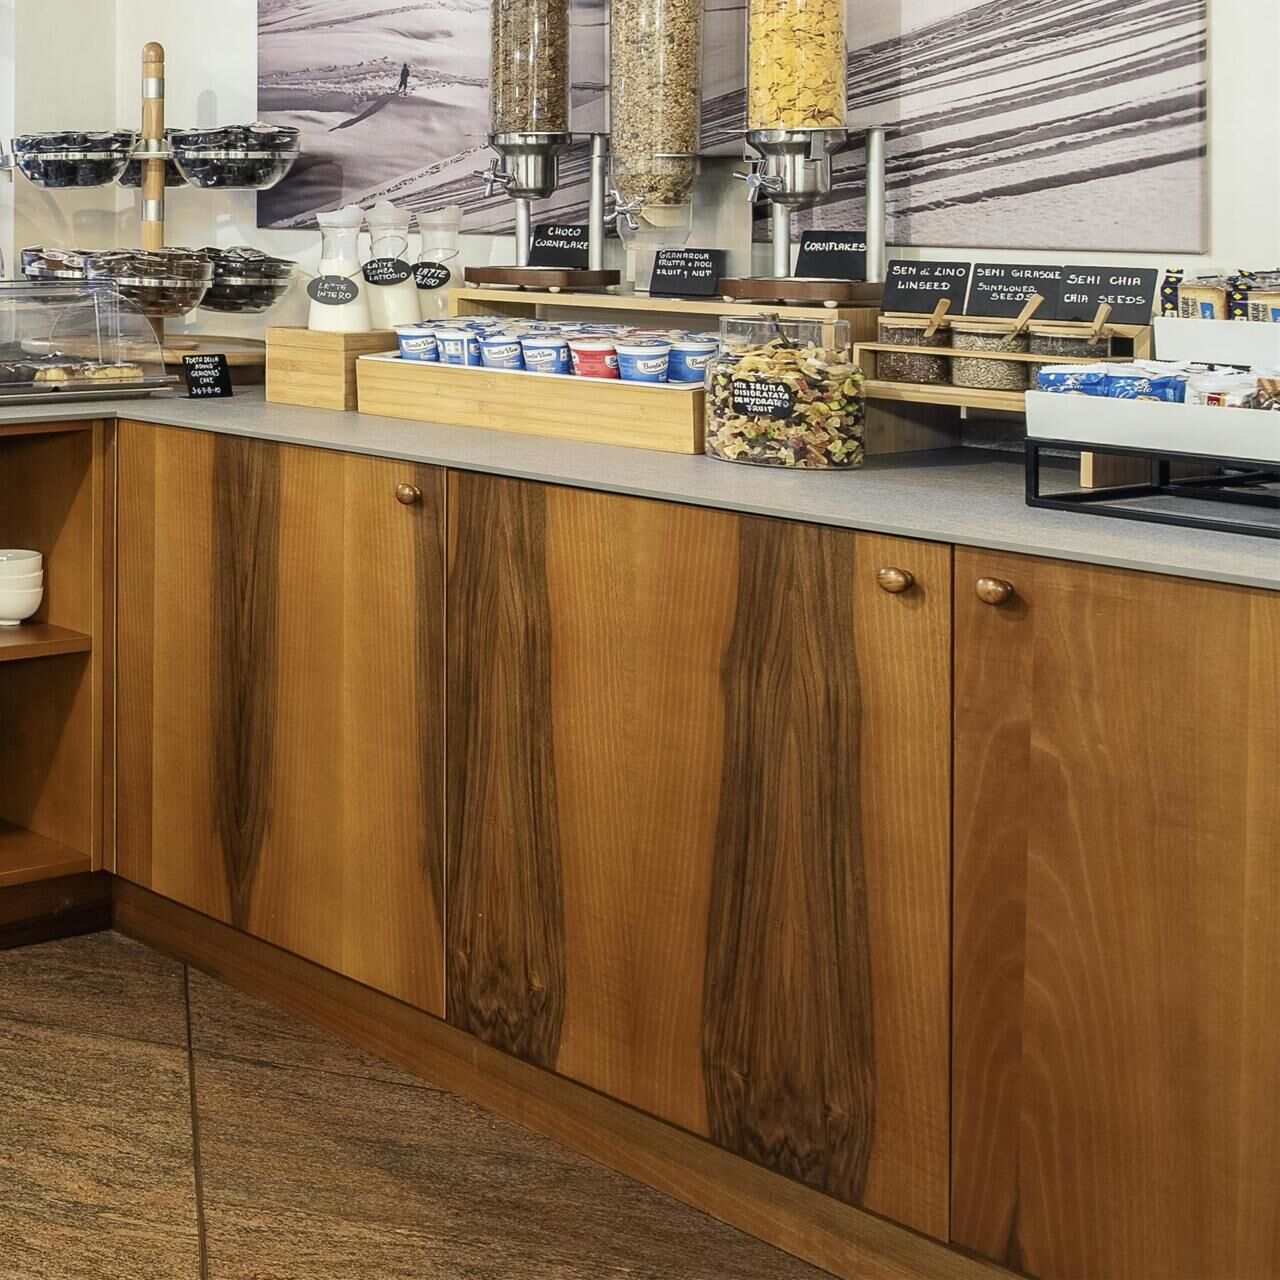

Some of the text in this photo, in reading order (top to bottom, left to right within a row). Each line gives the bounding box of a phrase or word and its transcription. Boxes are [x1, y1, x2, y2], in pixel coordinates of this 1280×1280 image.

[548, 227, 581, 236] CHOCO
[804, 241, 866, 252] CORNFLAKES
[369, 272, 407, 281] LATTOSIO
[416, 268, 448, 278] LATTE
[934, 268, 966, 276] LINO
[1011, 269, 1062, 279] GIRASOLE
[897, 281, 951, 290] LINSEED
[1109, 276, 1141, 286] CHIA
[317, 291, 352, 299] INTERO
[1064, 293, 1146, 305] CHIA SEEDS
